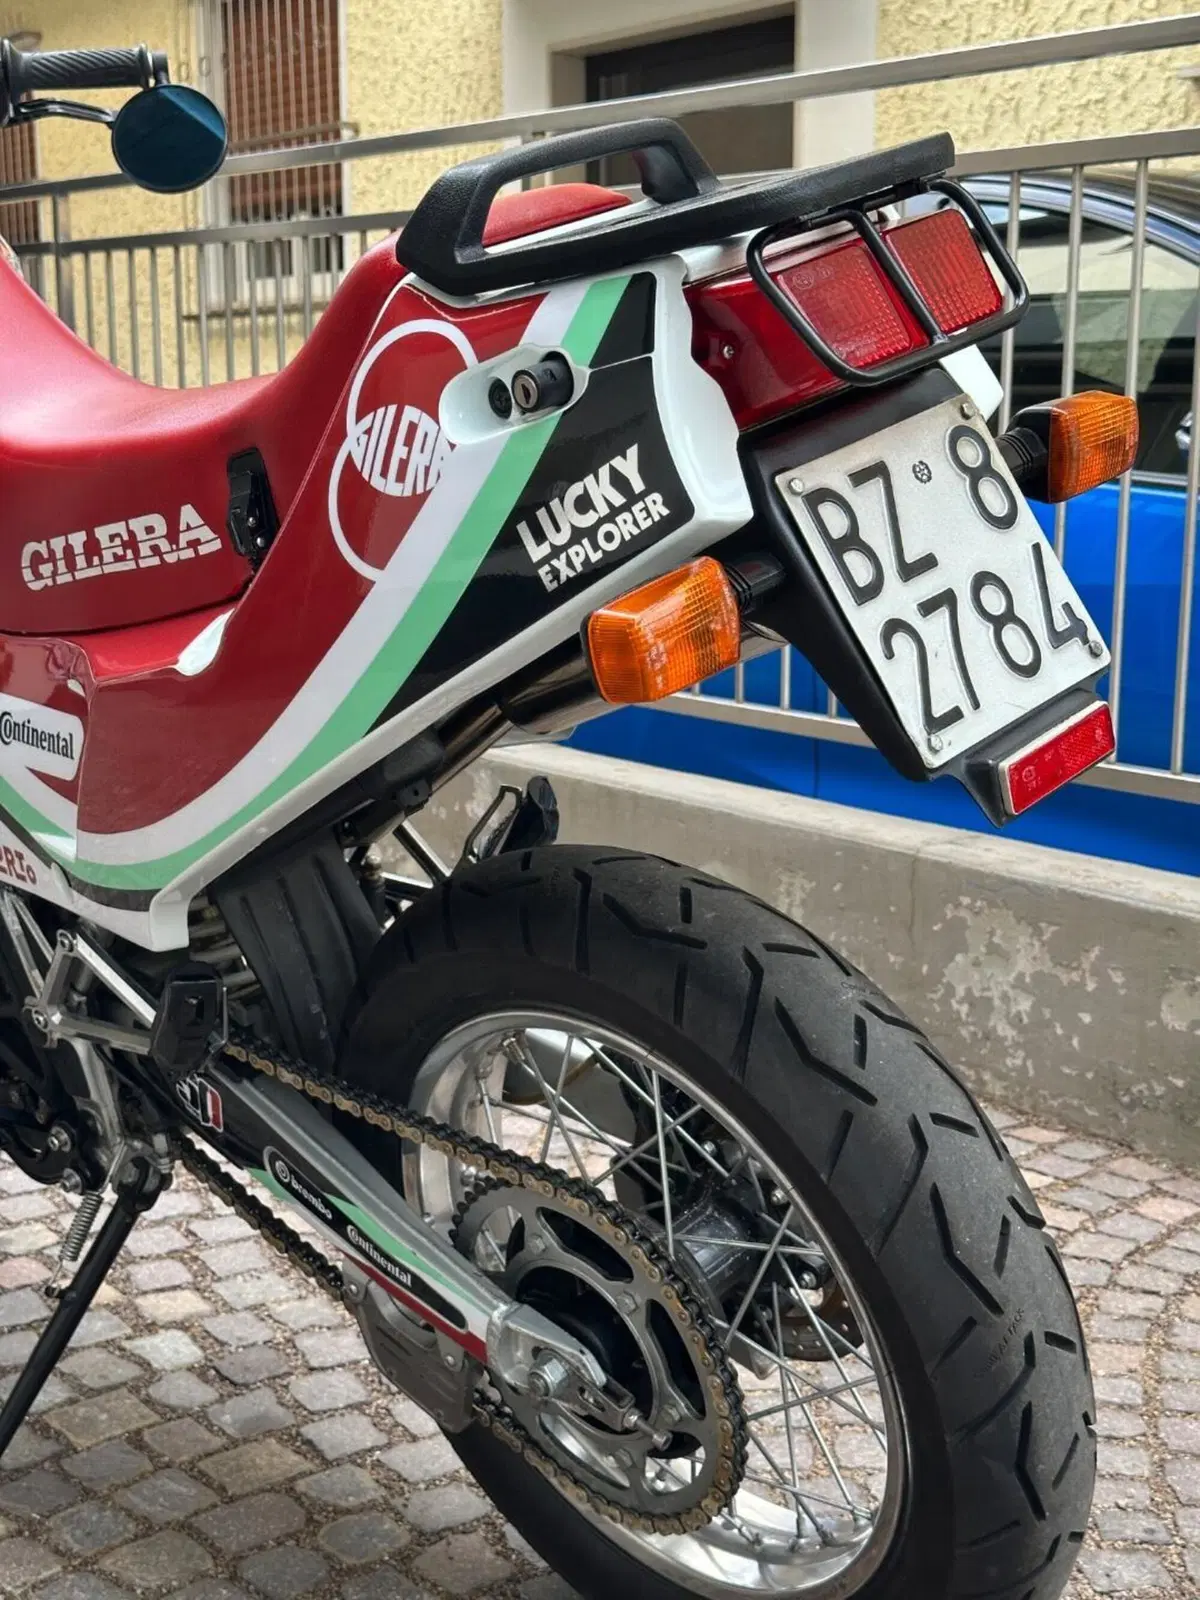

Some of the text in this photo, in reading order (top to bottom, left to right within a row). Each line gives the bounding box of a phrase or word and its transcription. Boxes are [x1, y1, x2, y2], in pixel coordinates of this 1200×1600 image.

[21, 503, 222, 591] GILERA
[516, 443, 646, 564] LUCKY
[537, 492, 670, 593] EXPLORER
[802, 424, 1018, 606] BZ 8
[880, 542, 1089, 734] 2784
[0, 711, 75, 760] Continental
[290, 1174, 333, 1220] brembo
[346, 1224, 412, 1287] Continental
